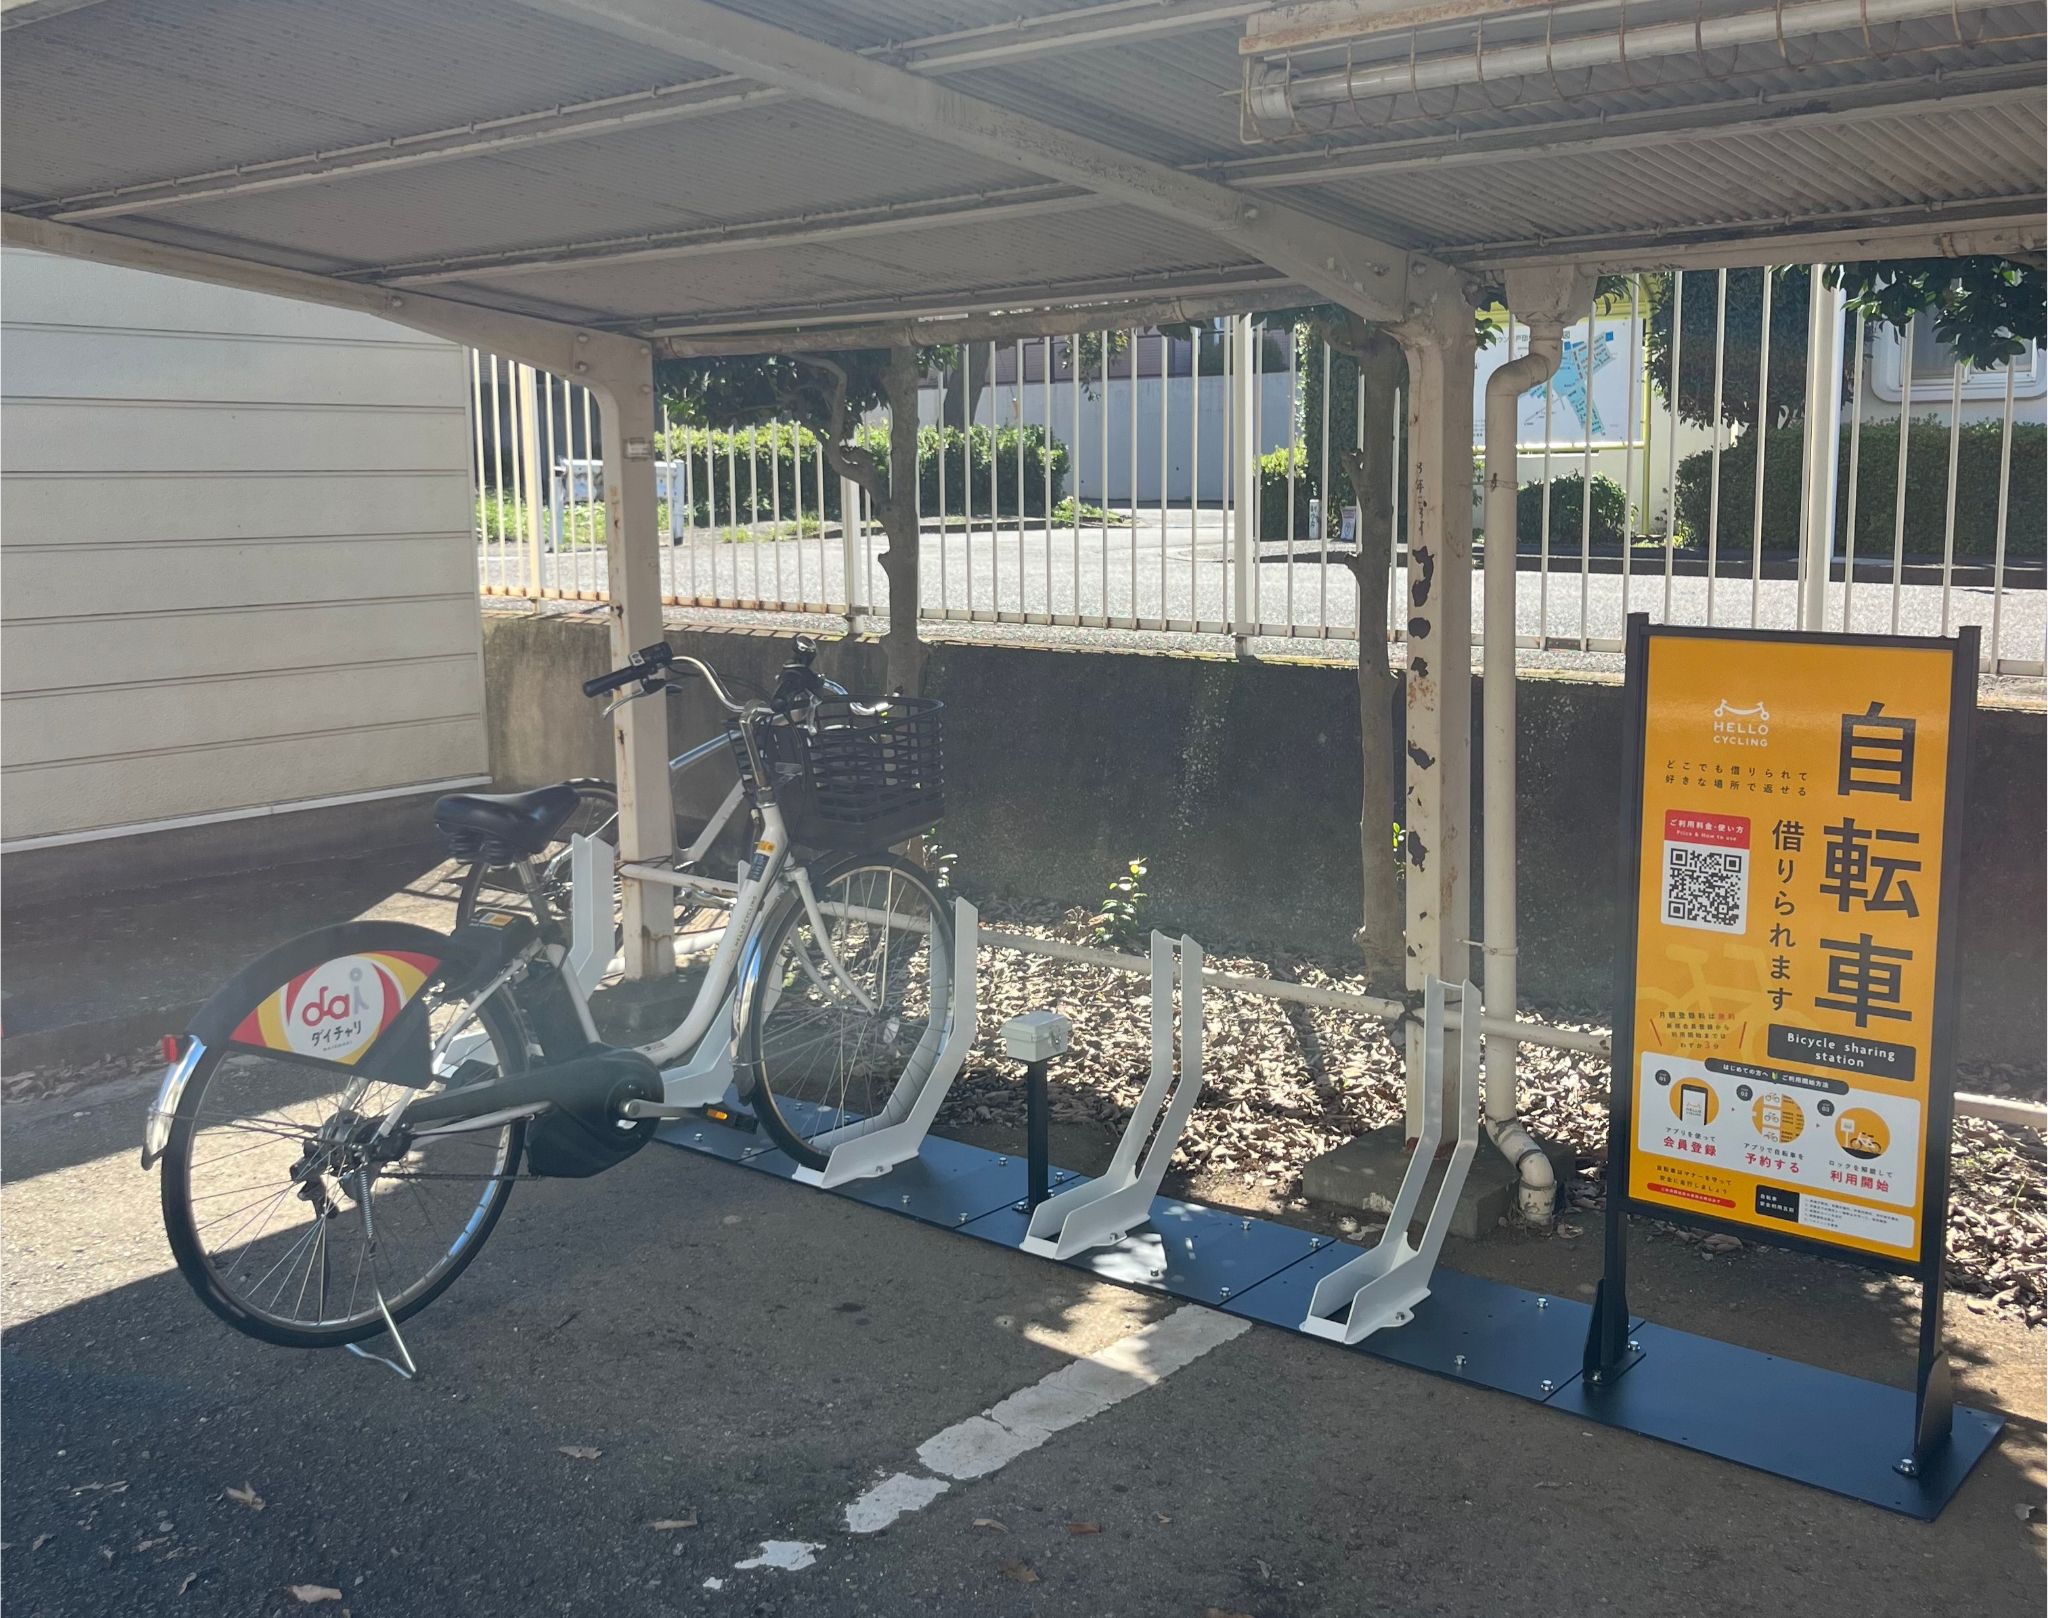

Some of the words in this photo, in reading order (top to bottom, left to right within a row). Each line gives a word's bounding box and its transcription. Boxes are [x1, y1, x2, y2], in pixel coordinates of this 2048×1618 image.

[1713, 720, 1769, 735] HELLO
[1713, 735, 1768, 747] CYCLING
[1666, 760, 1808, 781] どこでも借りられて
[1665, 774, 1807, 797] 好きな場所で返せる
[1670, 818, 1744, 834] ご利用料金・使い方
[1814, 701, 1922, 1028] 自転車
[1767, 819, 1805, 1011] 借りられます
[302, 967, 369, 1027] dai
[311, 1020, 362, 1047] ダイチャリ
[1787, 1032, 1836, 1049] Bicycle
[1844, 1042, 1895, 1062] sharing
[1815, 1051, 1864, 1067] station
[1722, 1063, 1769, 1077] はじめての方へ
[1781, 1074, 1829, 1089] ご利用開始方法
[1665, 1127, 1716, 1142] アプリを使って
[1663, 1136, 1717, 1157] 会員登録
[1744, 1142, 1804, 1161] アプリで自転車を
[1744, 1153, 1800, 1174] 予約する
[1830, 1170, 1889, 1193] 利用開始
